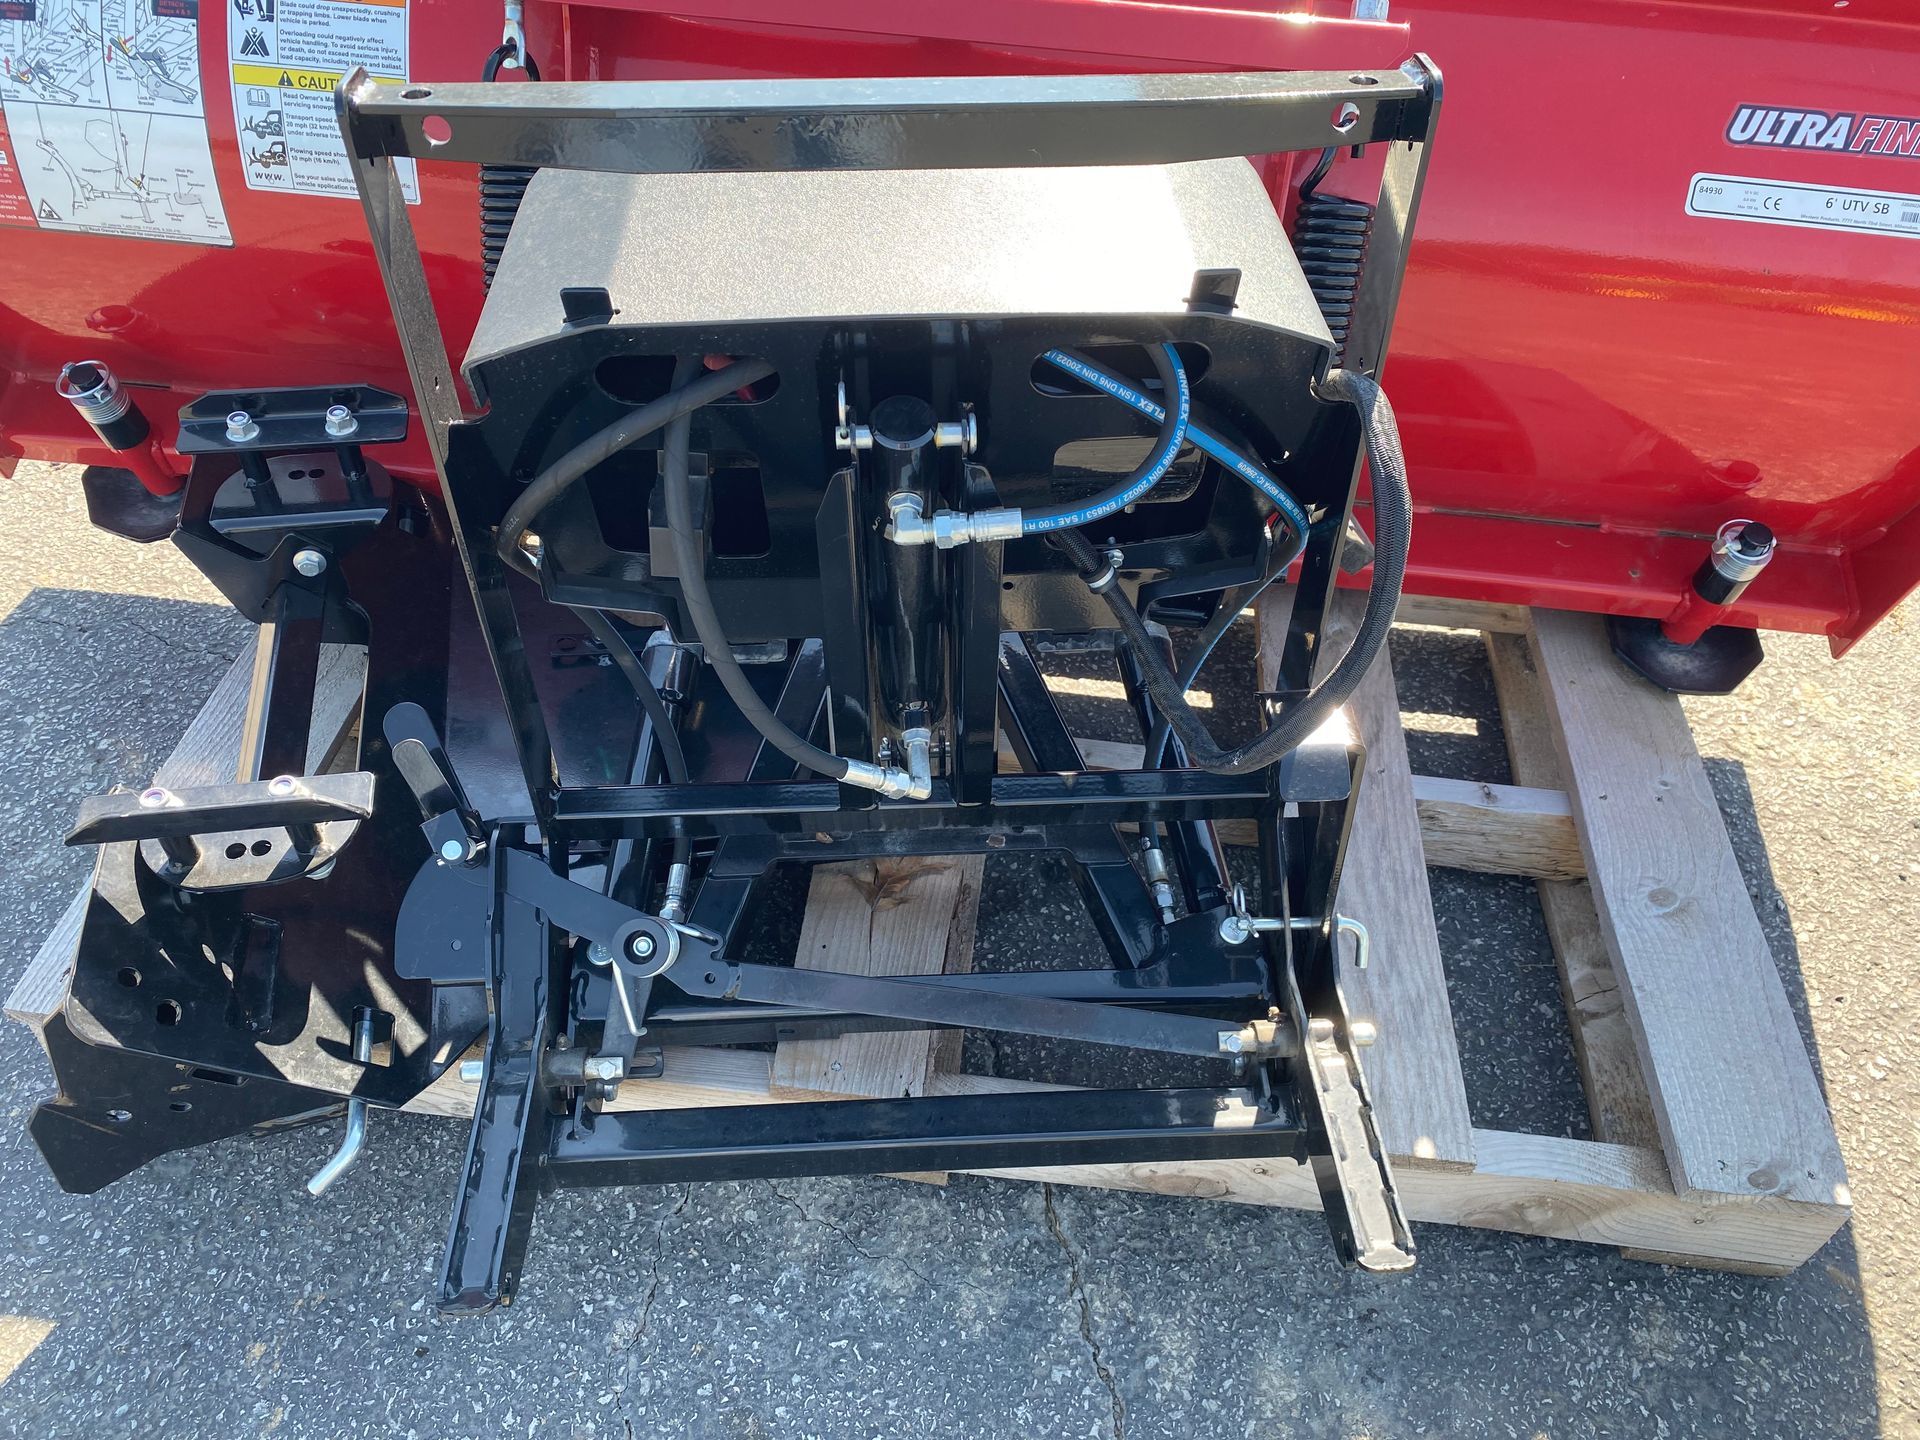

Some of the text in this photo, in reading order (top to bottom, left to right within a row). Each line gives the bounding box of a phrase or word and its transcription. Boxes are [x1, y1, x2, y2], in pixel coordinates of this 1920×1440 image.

[287, 10, 313, 18] trapping
[313, 11, 332, 19] limbs.
[374, 10, 401, 18] crushing
[280, 29, 316, 39] Overloading
[335, 35, 366, 44] negatively
[302, 40, 329, 48] handling.
[380, 46, 398, 54] injury
[294, 55, 321, 64] capacity,
[321, 57, 350, 66] including
[381, 62, 403, 71] ballast.
[350, 52, 380, 60] maximum
[298, 76, 340, 91] CAUT
[300, 93, 324, 102] Owner's
[284, 101, 311, 110] servicing
[285, 113, 314, 121] Transport
[1850, 118, 1920, 157] FIN
[290, 147, 313, 156] Plowing
[295, 180, 316, 188] vehicle
[1699, 185, 1723, 195] 84930
[1825, 197, 1838, 209] 6'
[1842, 199, 1870, 213] UTV
[1873, 202, 1890, 215] SB
[1056, 354, 1083, 372] 20022
[1082, 367, 1099, 382] DIN
[1099, 377, 1118, 392] DN6
[1118, 388, 1136, 402] 1SN
[1138, 398, 1166, 420] FLEX
[1174, 425, 1185, 445] 1SN
[1162, 445, 1177, 467] DN6
[1148, 465, 1164, 483] DIN
[1122, 480, 1149, 503] 20022
[1263, 482, 1280, 496] MSHA
[1086, 501, 1117, 519] EN853
[1023, 521, 1037, 531] R1
[1038, 520, 1056, 529] 100
[1058, 514, 1079, 526] SAE
